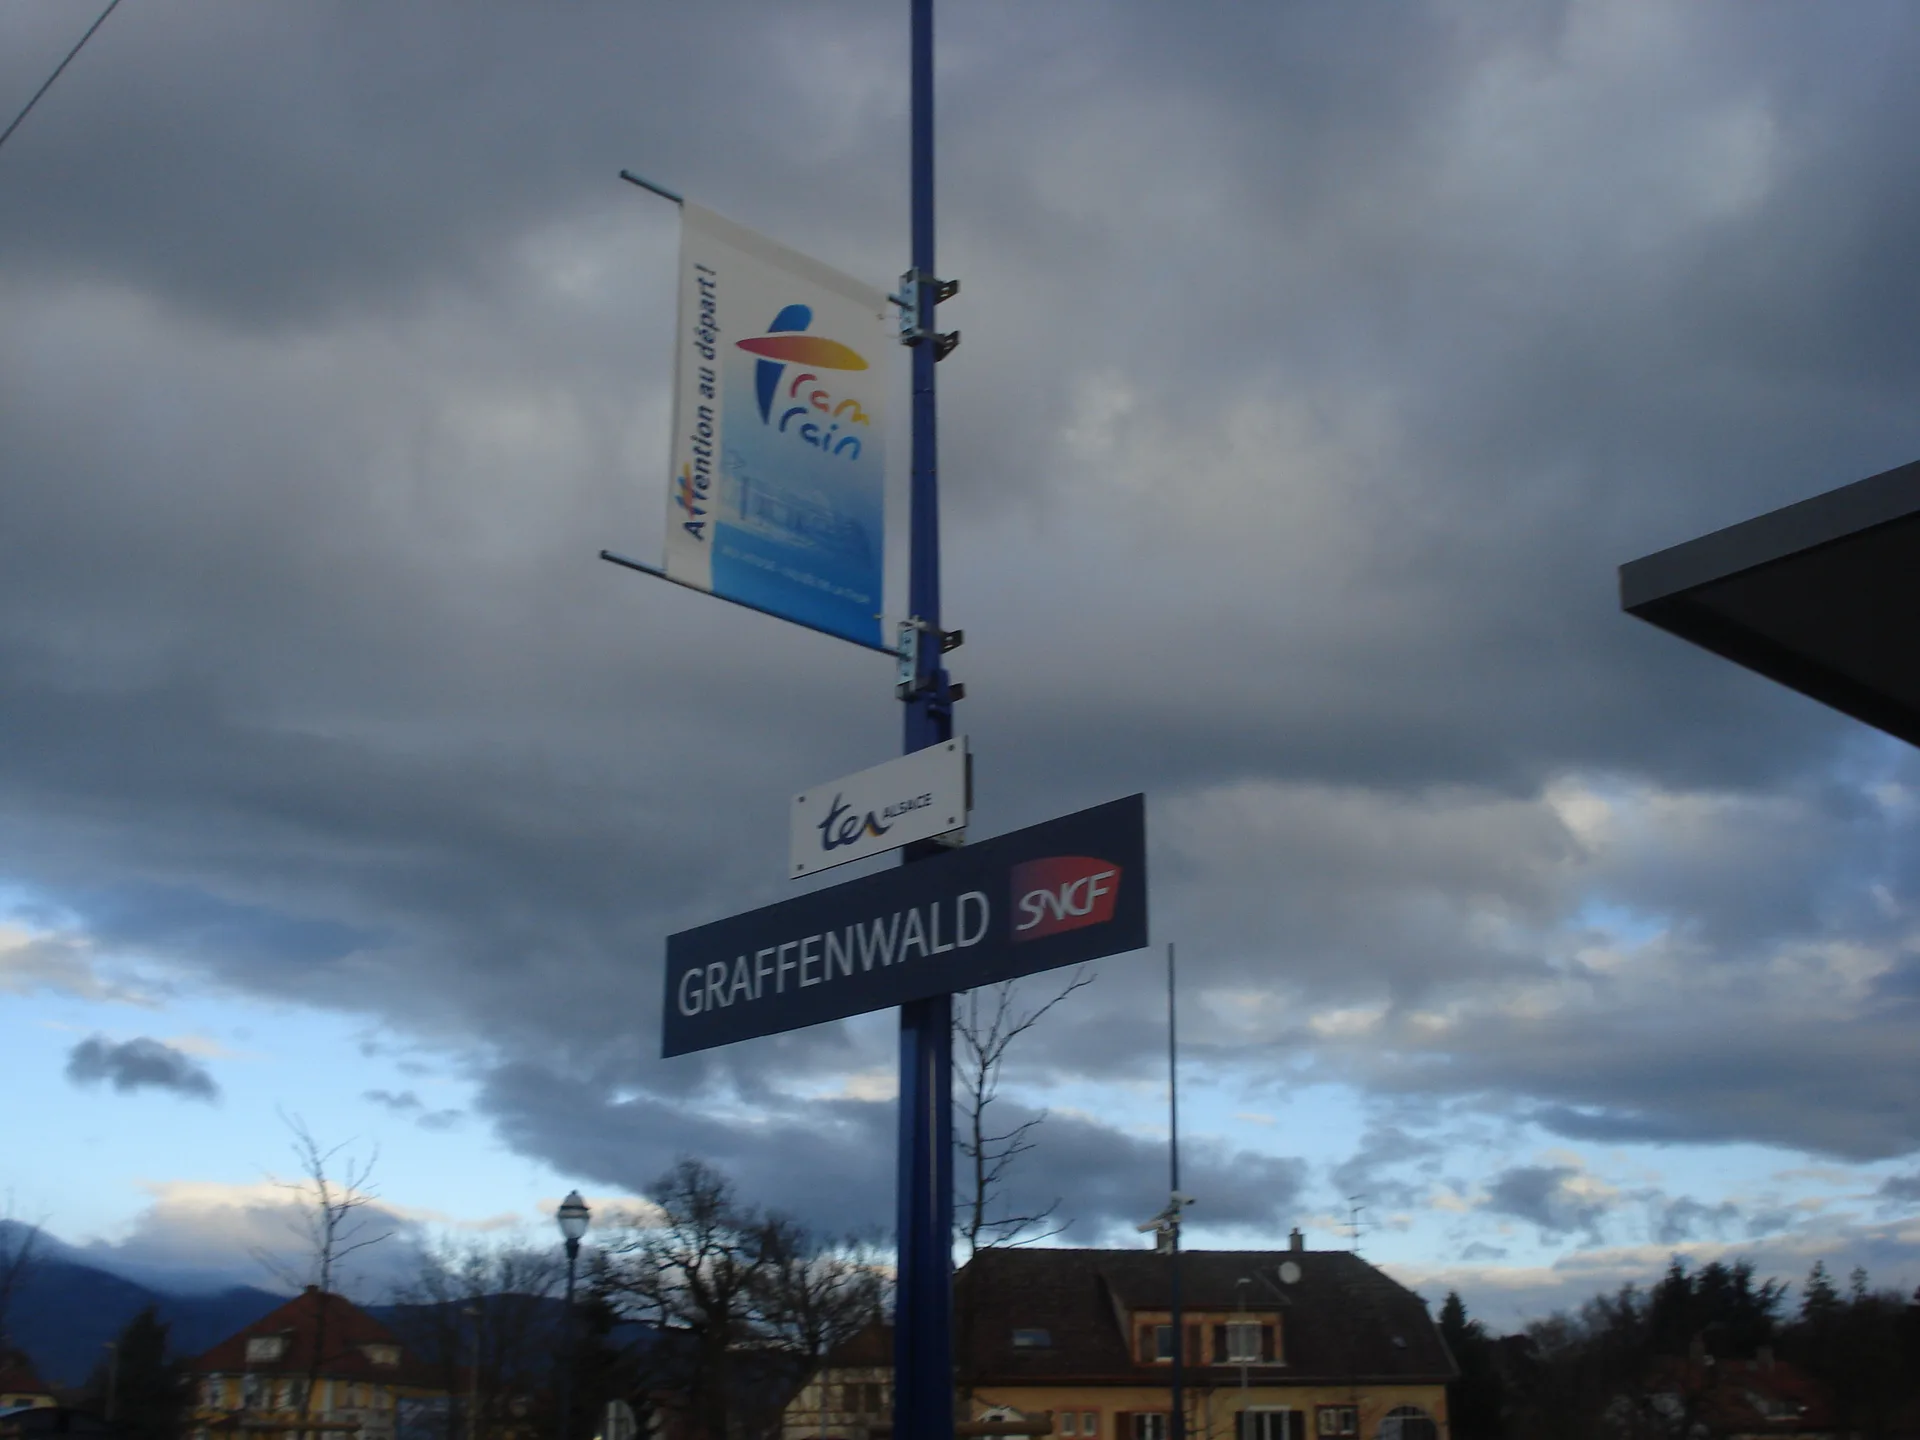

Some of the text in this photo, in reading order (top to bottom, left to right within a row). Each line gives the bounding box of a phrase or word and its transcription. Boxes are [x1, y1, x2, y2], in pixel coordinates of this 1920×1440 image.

[675, 404, 713, 540] Attention
[698, 366, 716, 400] au
[883, 792, 932, 819] ALSACE
[1016, 869, 1116, 932] SNCF
[678, 891, 990, 1017] GRAFFENWALD
